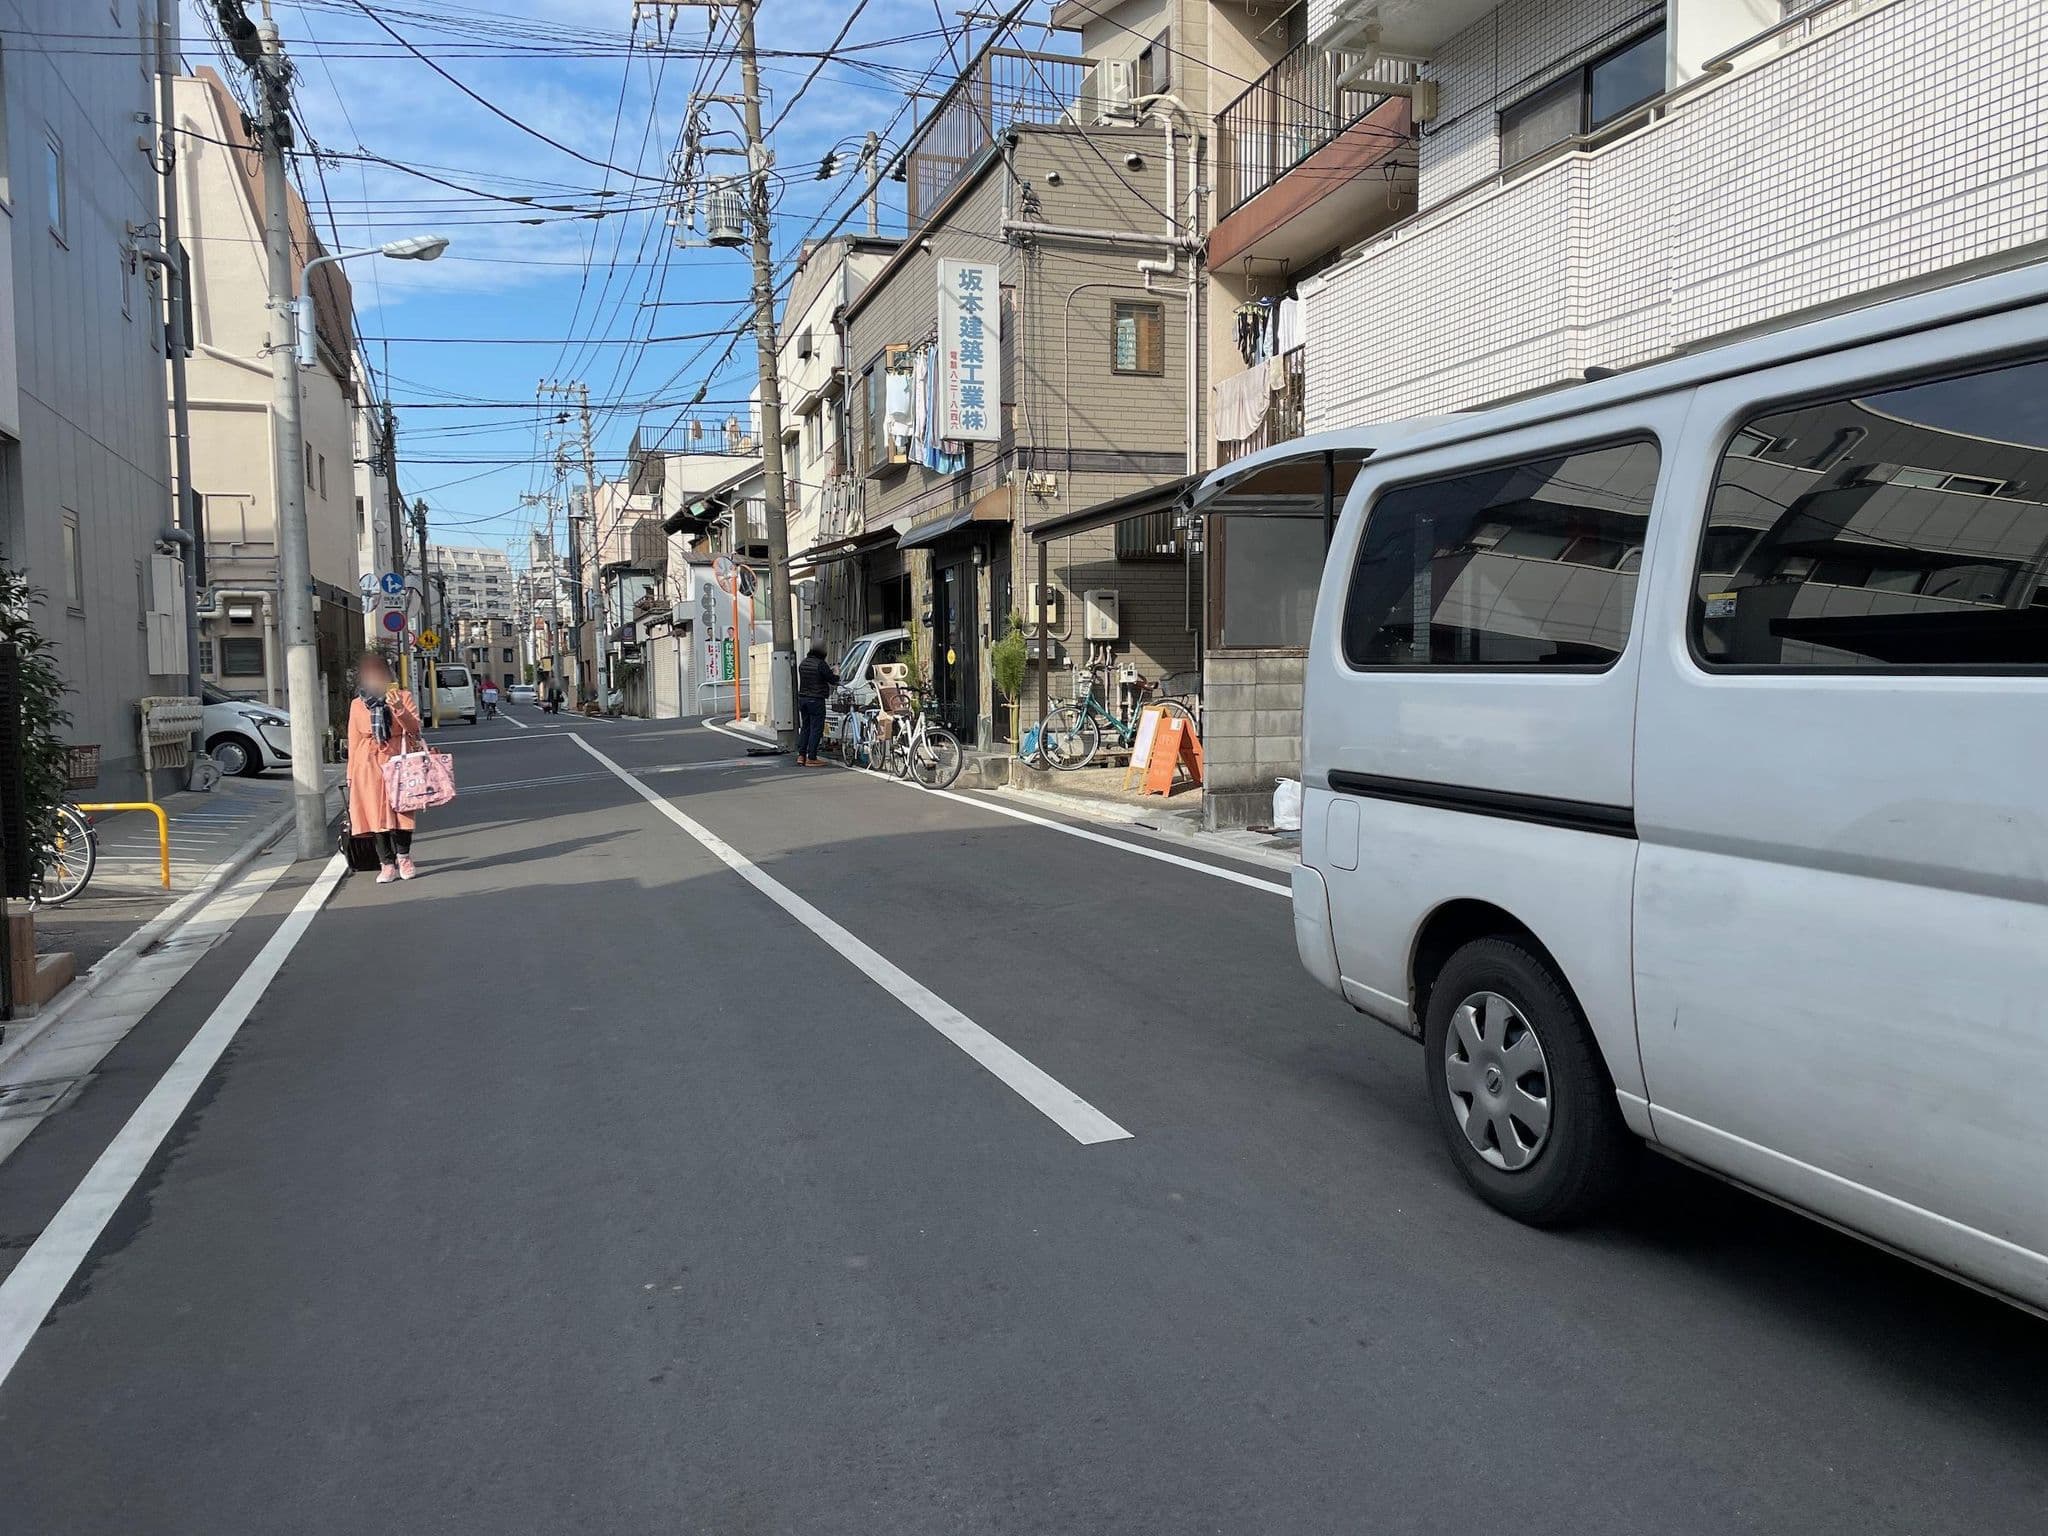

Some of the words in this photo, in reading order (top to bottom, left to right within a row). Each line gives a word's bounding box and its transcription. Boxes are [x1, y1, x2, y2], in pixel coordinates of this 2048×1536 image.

[958, 268, 988, 431] 坂本建築工業(株)
